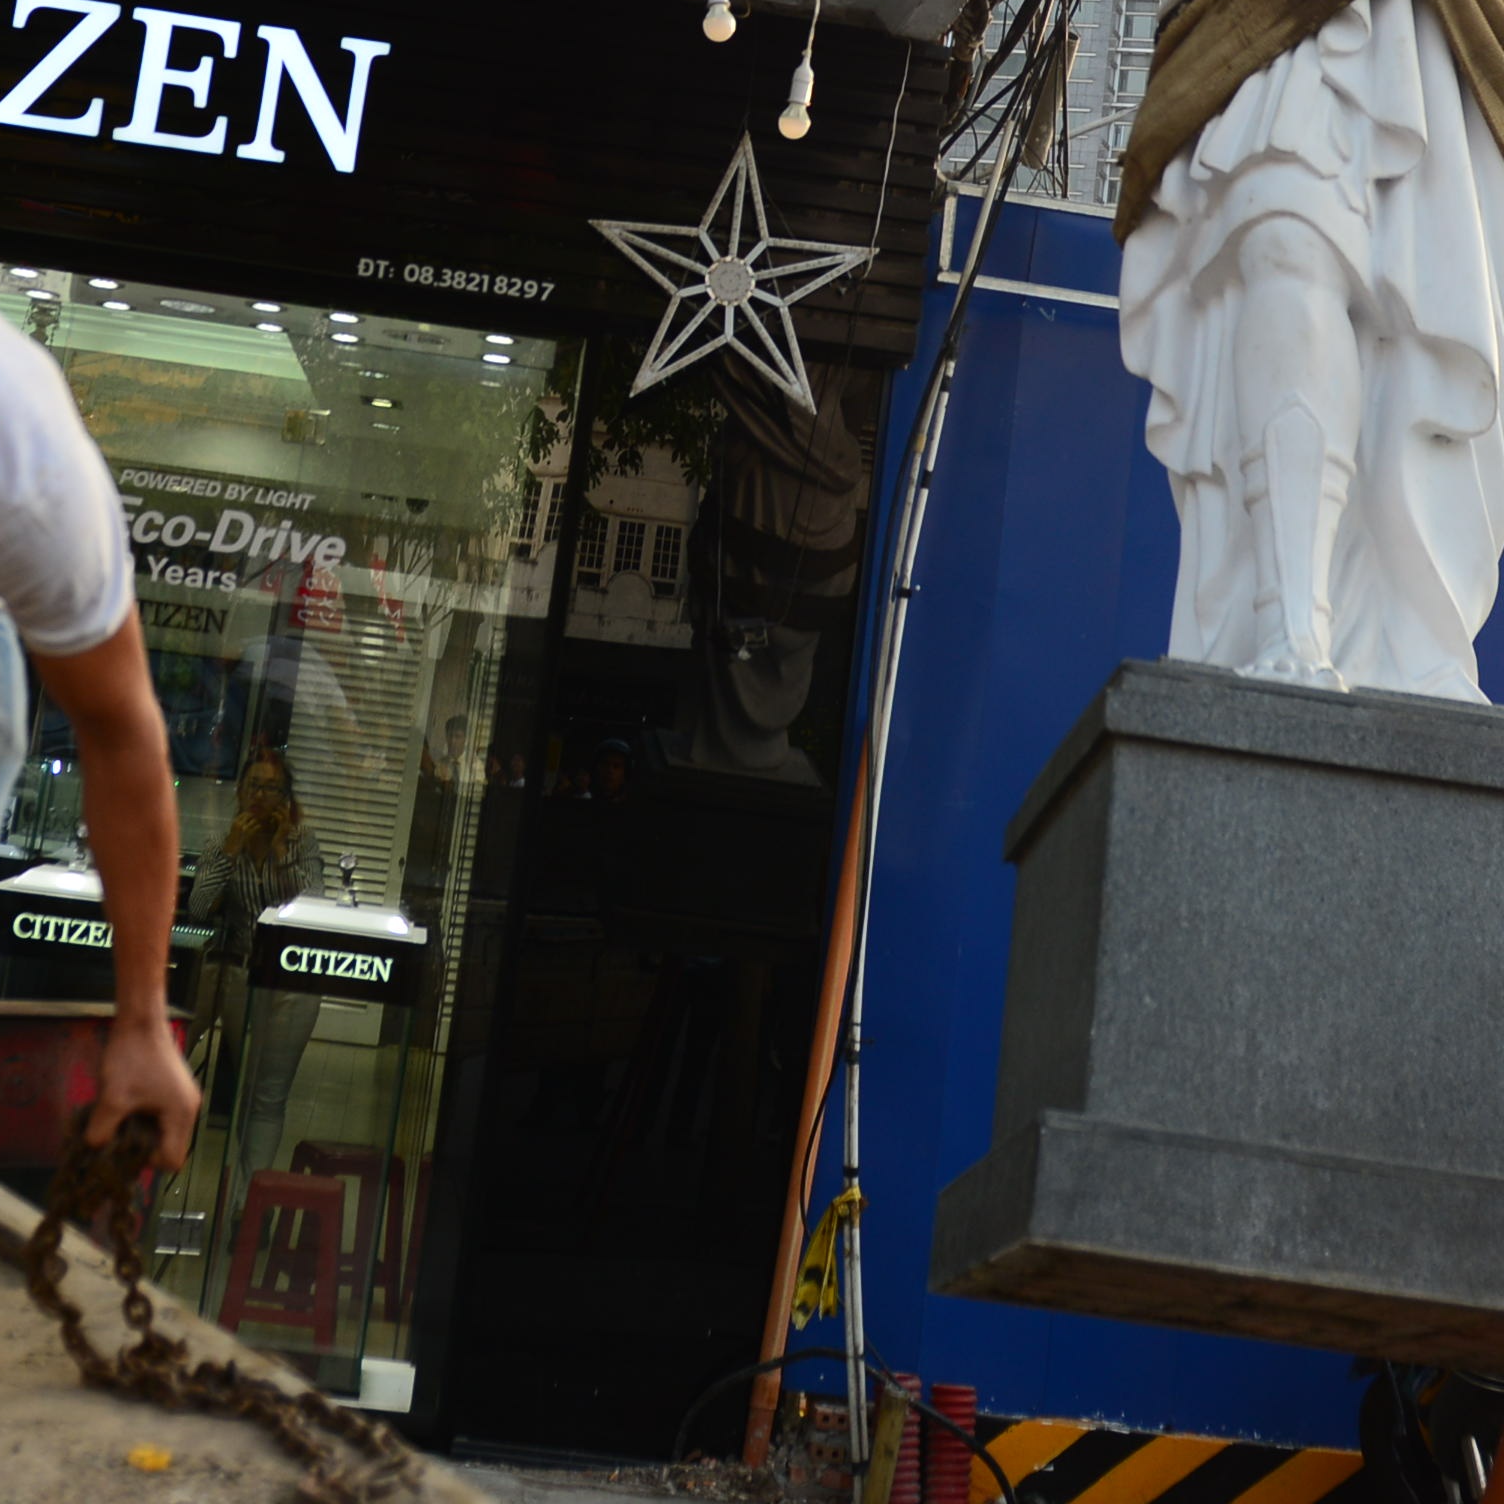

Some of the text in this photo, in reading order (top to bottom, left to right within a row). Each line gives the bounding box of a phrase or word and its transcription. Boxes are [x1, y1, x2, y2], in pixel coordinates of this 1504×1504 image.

[357, 258, 394, 279] ĐT:
[119, 469, 316, 511] POWERED BY LIGHT
[120, 494, 346, 569] Eco-Drive
[147, 554, 237, 593] Years
[139, 598, 229, 634] TIZEN
[280, 945, 393, 983] CITIZEN
